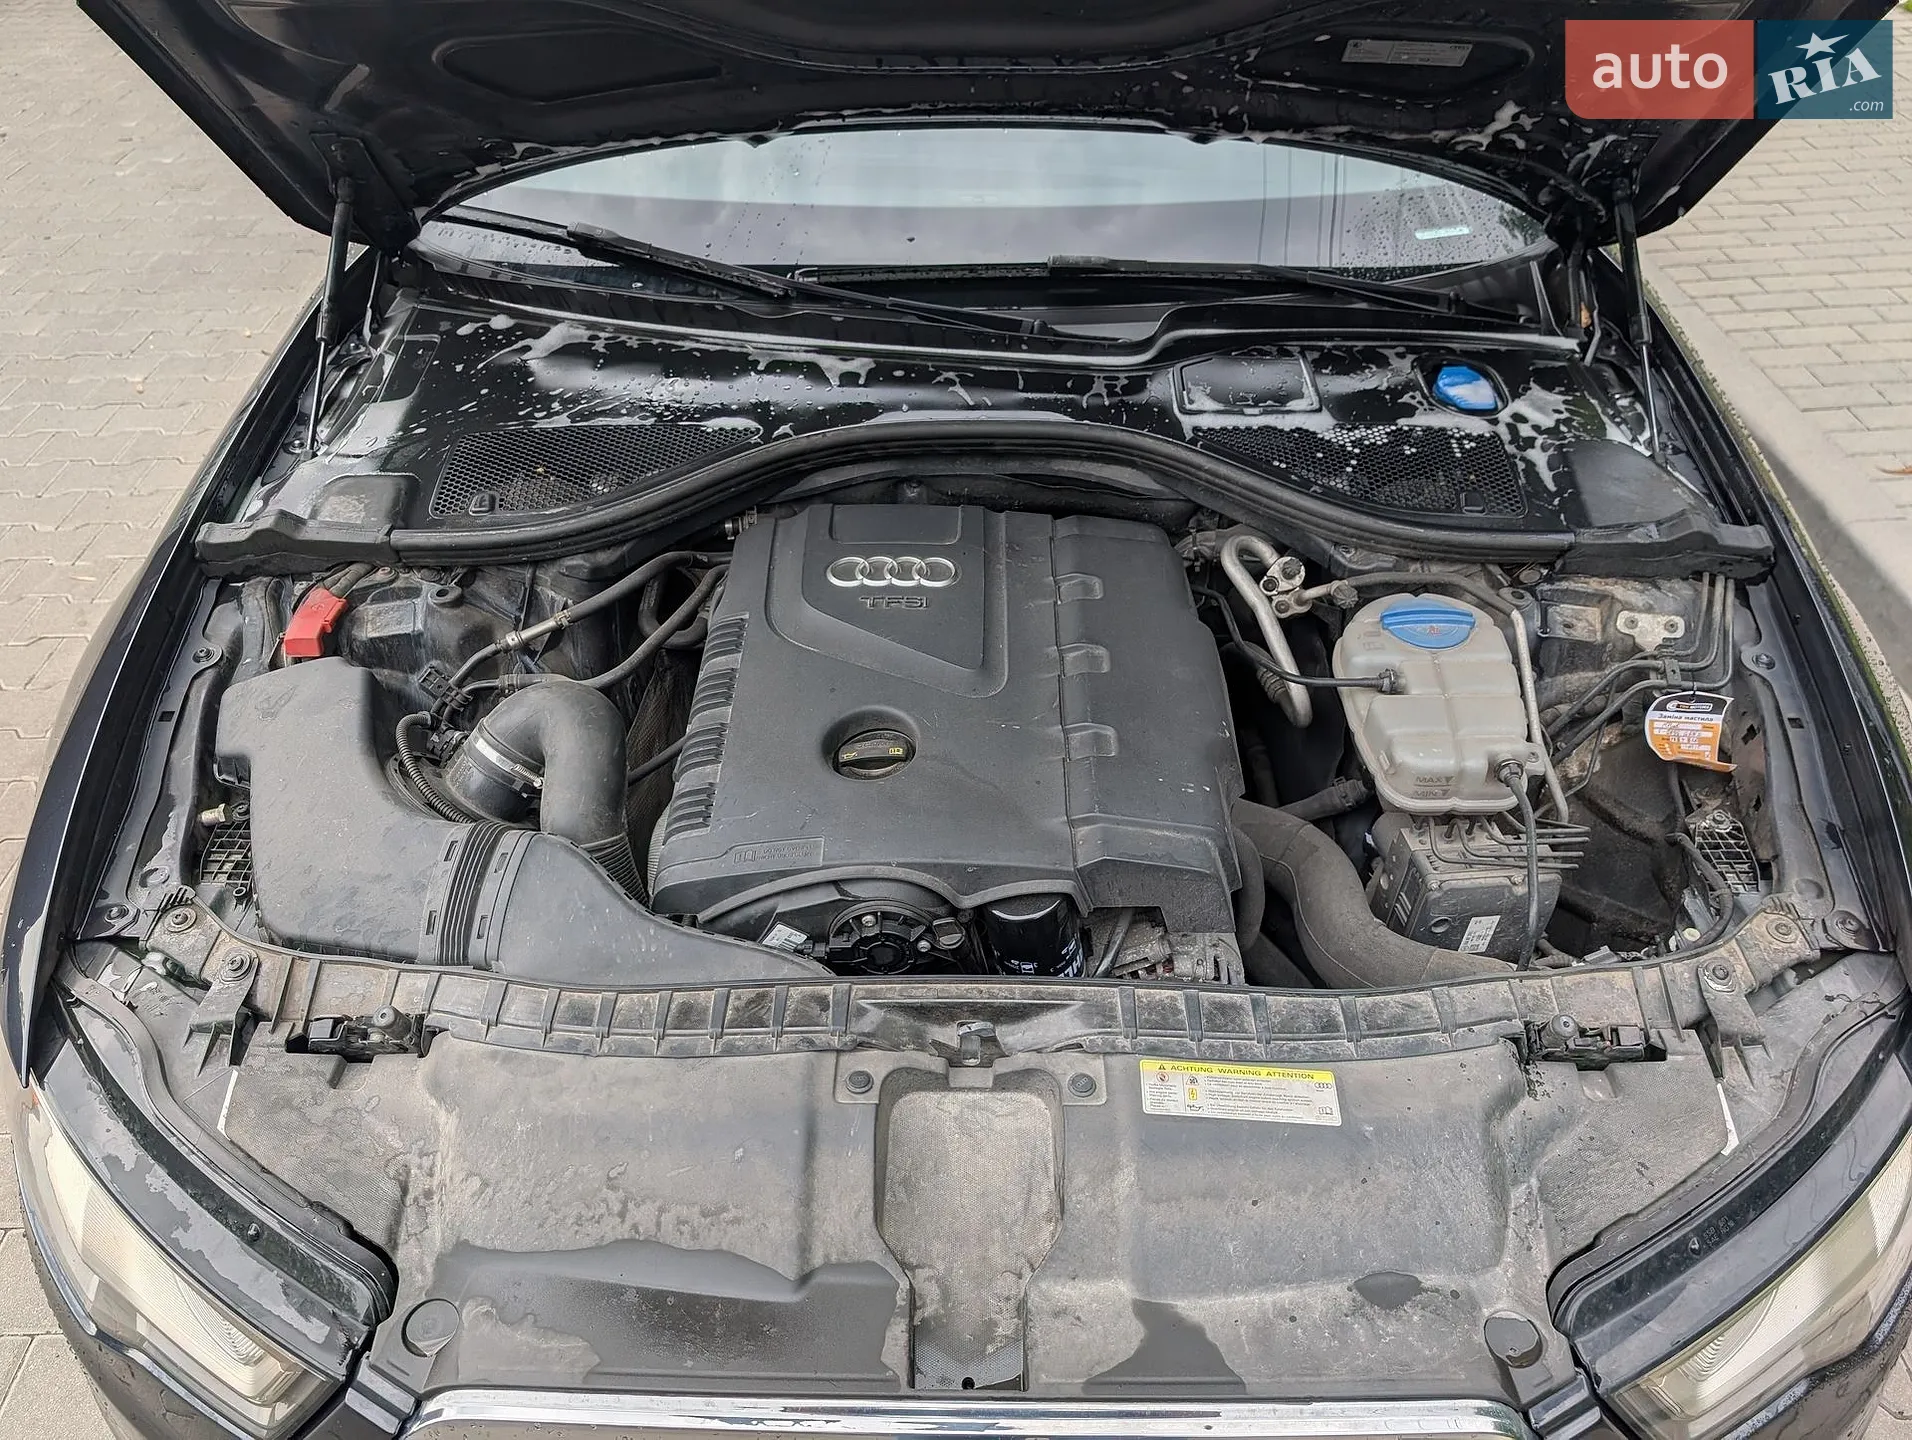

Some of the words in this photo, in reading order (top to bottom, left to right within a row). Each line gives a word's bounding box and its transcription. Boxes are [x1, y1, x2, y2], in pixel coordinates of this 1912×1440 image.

[859, 595, 928, 610] TFSI
[1171, 1064, 1213, 1073] ACHTUNG
[1218, 1068, 1261, 1076] WARNING
[1266, 1071, 1315, 1080] ATTENTION
